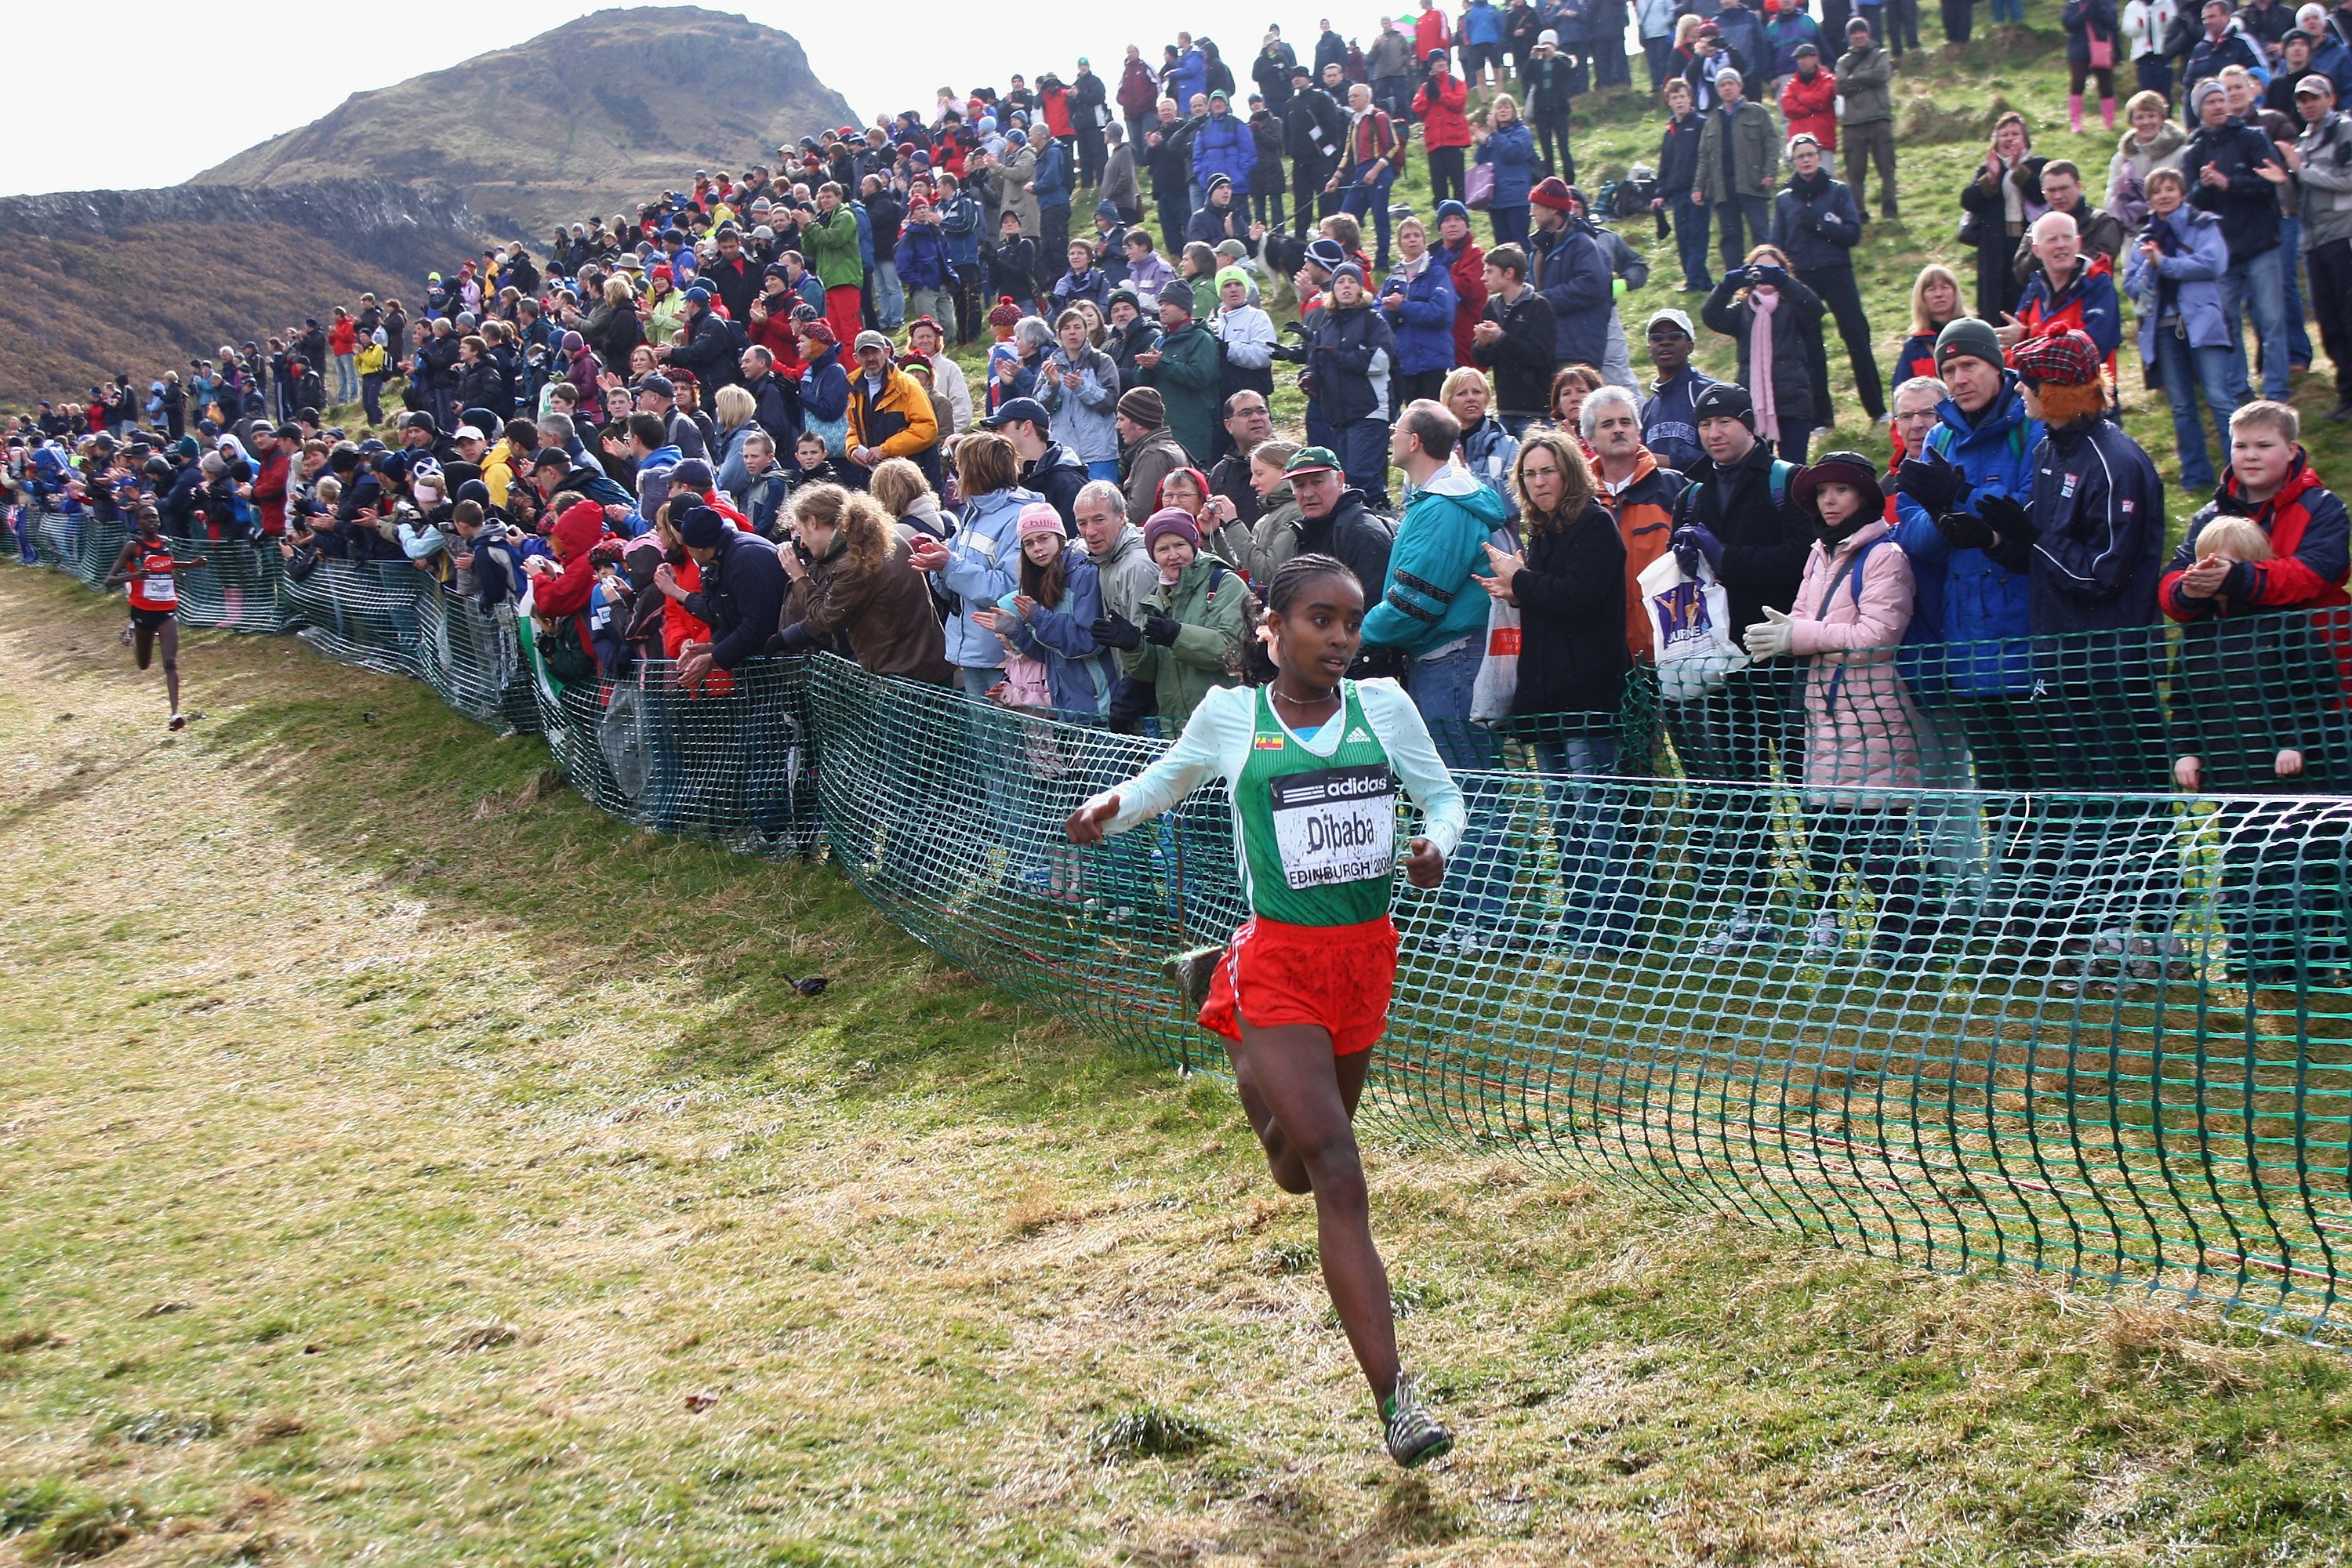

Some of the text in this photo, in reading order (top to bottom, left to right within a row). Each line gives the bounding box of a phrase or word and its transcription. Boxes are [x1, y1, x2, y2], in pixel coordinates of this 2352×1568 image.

[1327, 776, 1387, 797] adidas
[1306, 811, 1375, 852] Dibaba
[1289, 861, 1370, 885] EDINBURGH
